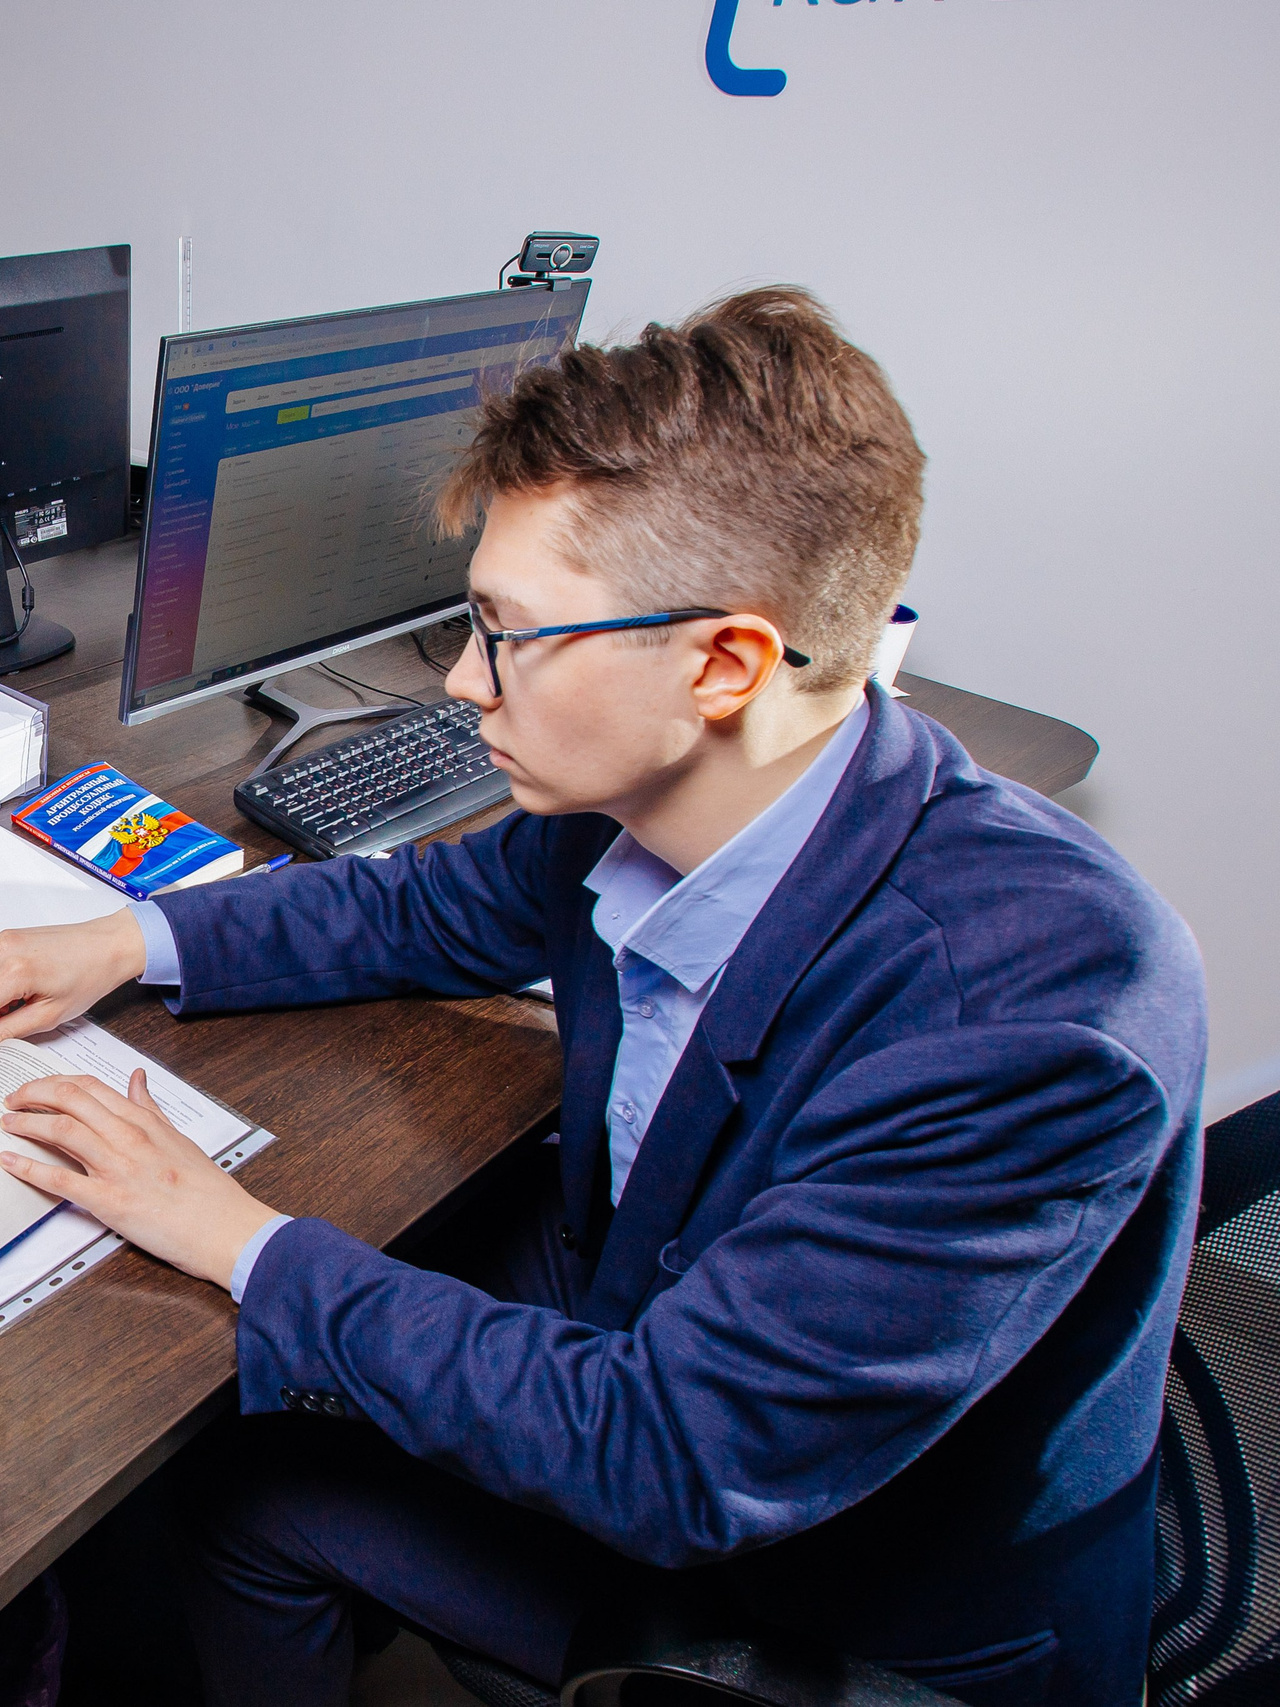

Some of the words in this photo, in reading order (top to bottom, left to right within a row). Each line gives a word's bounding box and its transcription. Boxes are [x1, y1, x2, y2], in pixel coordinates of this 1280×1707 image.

[174, 385, 190, 395] ООО
[45, 774, 110, 816] АРБИТРАЖНЫЙ
[47, 778, 127, 826] ПРОЦЕССУАЛЬНЫЙ
[78, 792, 115, 816] КОДЕКС
